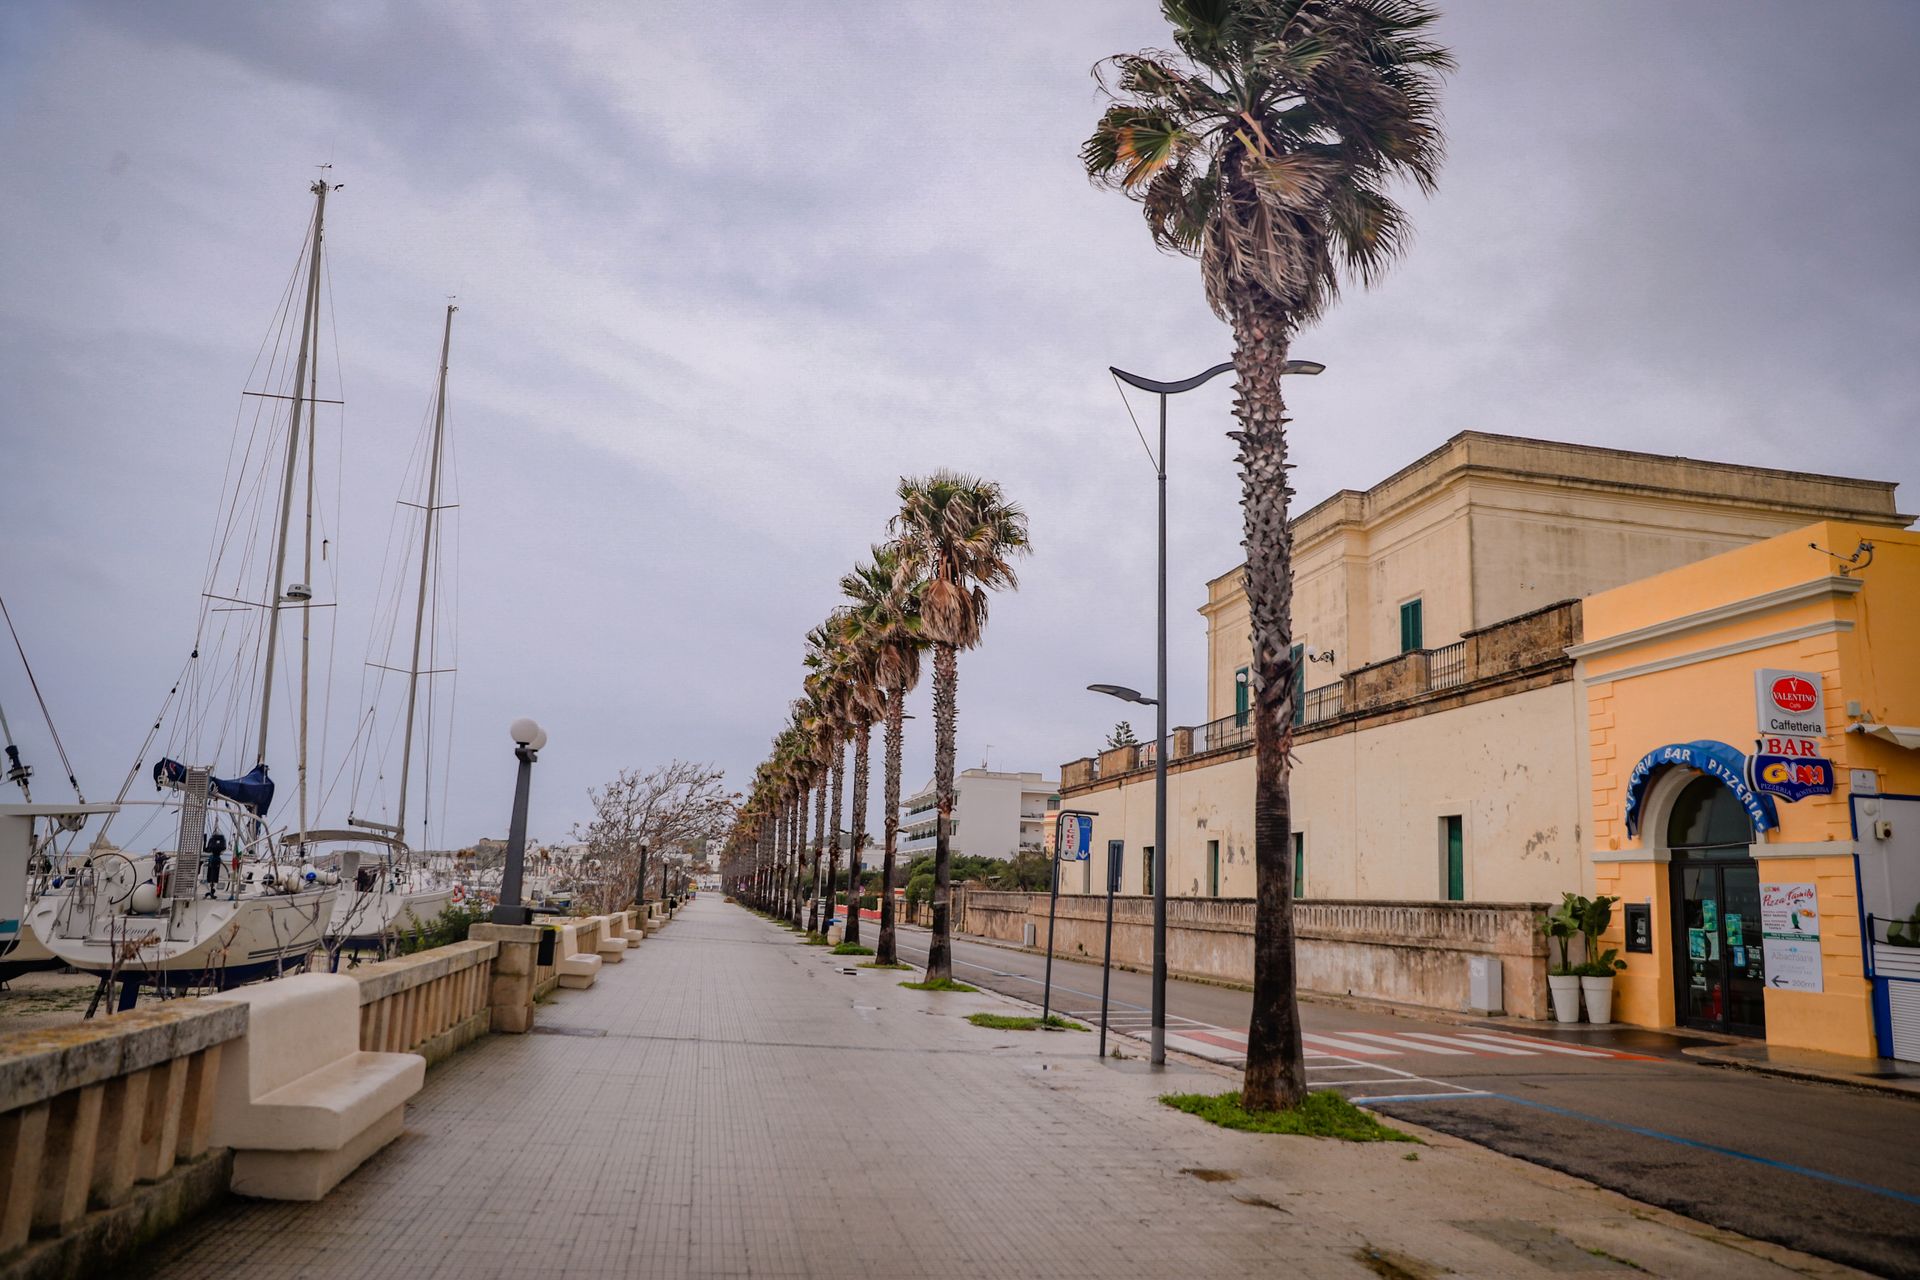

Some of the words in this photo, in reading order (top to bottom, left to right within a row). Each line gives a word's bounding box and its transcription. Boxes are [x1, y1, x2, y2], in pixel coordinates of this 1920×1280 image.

[1773, 691, 1816, 702] VALENTINO
[1771, 719, 1822, 733] Caffetteria
[1664, 747, 1691, 761] BAR
[1767, 738, 1817, 757] BAR
[1763, 761, 1824, 786] GNAM
[1760, 783, 1792, 796] PIZZERIA
[1066, 817, 1075, 849] TICKET
